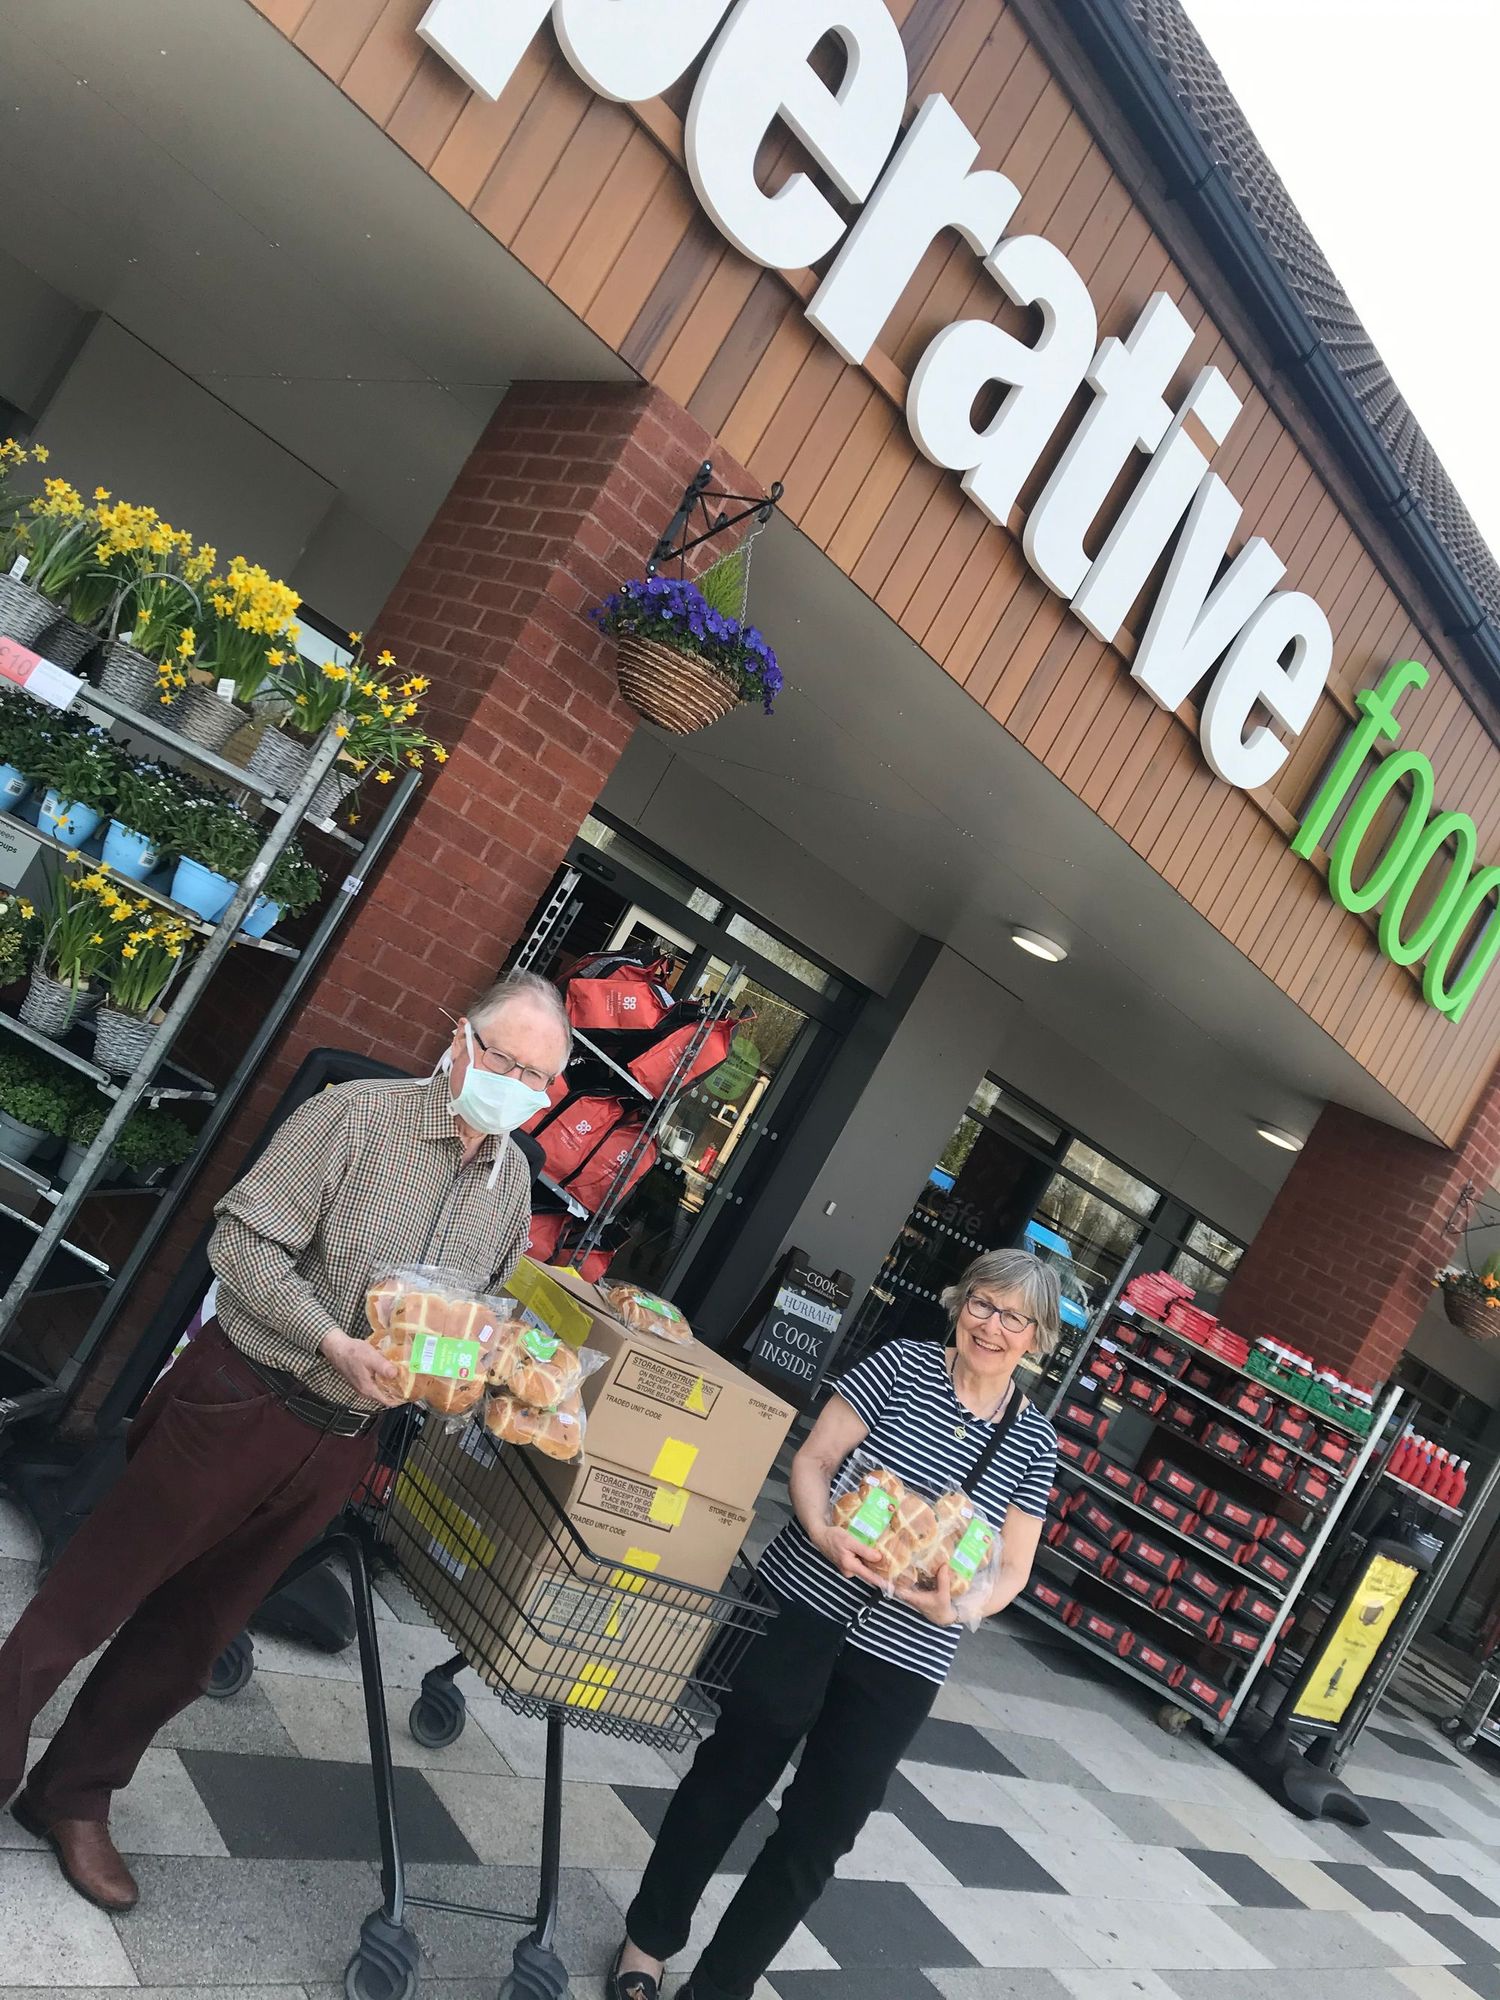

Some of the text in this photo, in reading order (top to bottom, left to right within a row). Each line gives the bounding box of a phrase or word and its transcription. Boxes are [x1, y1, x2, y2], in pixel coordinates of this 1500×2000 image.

[806, 1272, 839, 1296] COOK
[783, 1295, 834, 1326] HURRAH!
[772, 1321, 823, 1358] COOK
[632, 1356, 666, 1375] STORAGE
[759, 1340, 816, 1381] INSIDE
[638, 1378, 656, 1389] PLACE
[656, 1384, 670, 1394] INTO
[639, 1370, 648, 1378] ON
[648, 1373, 671, 1386] RECEIPT
[672, 1381, 680, 1389] OF
[636, 1384, 655, 1396] STORE
[656, 1391, 675, 1403] BELOW
[606, 1394, 662, 1420] TRADED UNIT CODE
[748, 1398, 789, 1419] STORE BELOW
[595, 1472, 627, 1490] STORAGE
[601, 1493, 619, 1505] PLACE
[620, 1499, 634, 1509] INTO
[602, 1486, 610, 1494] ON
[611, 1489, 634, 1502] RECEIPT
[634, 1496, 643, 1504] OF
[601, 1501, 618, 1512] STORE
[619, 1507, 639, 1519] BELOW
[708, 1505, 748, 1523] STORE BELOW
[570, 1513, 627, 1537] TRADED UNIT CODE
